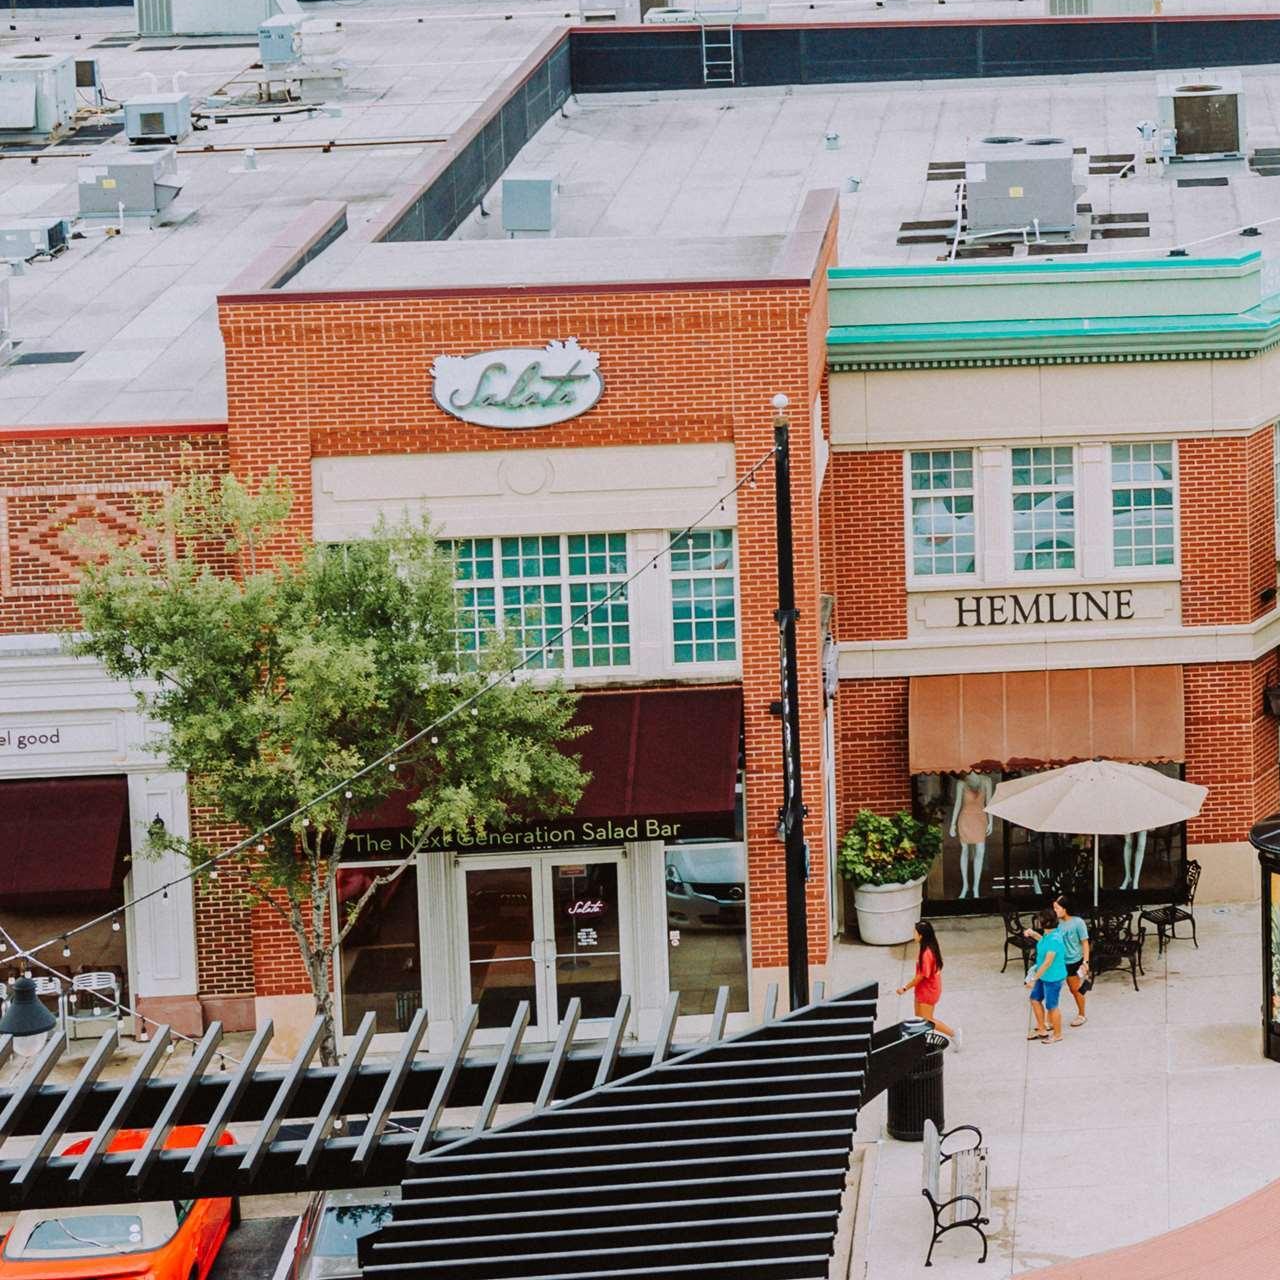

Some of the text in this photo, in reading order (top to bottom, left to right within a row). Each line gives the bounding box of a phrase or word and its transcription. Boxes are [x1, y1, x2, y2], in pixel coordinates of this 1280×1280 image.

[450, 359, 591, 410] Salata
[954, 589, 1136, 628] HEMLINE
[17, 728, 60, 749] good
[353, 820, 681, 853] The Next Generation Salad Bar
